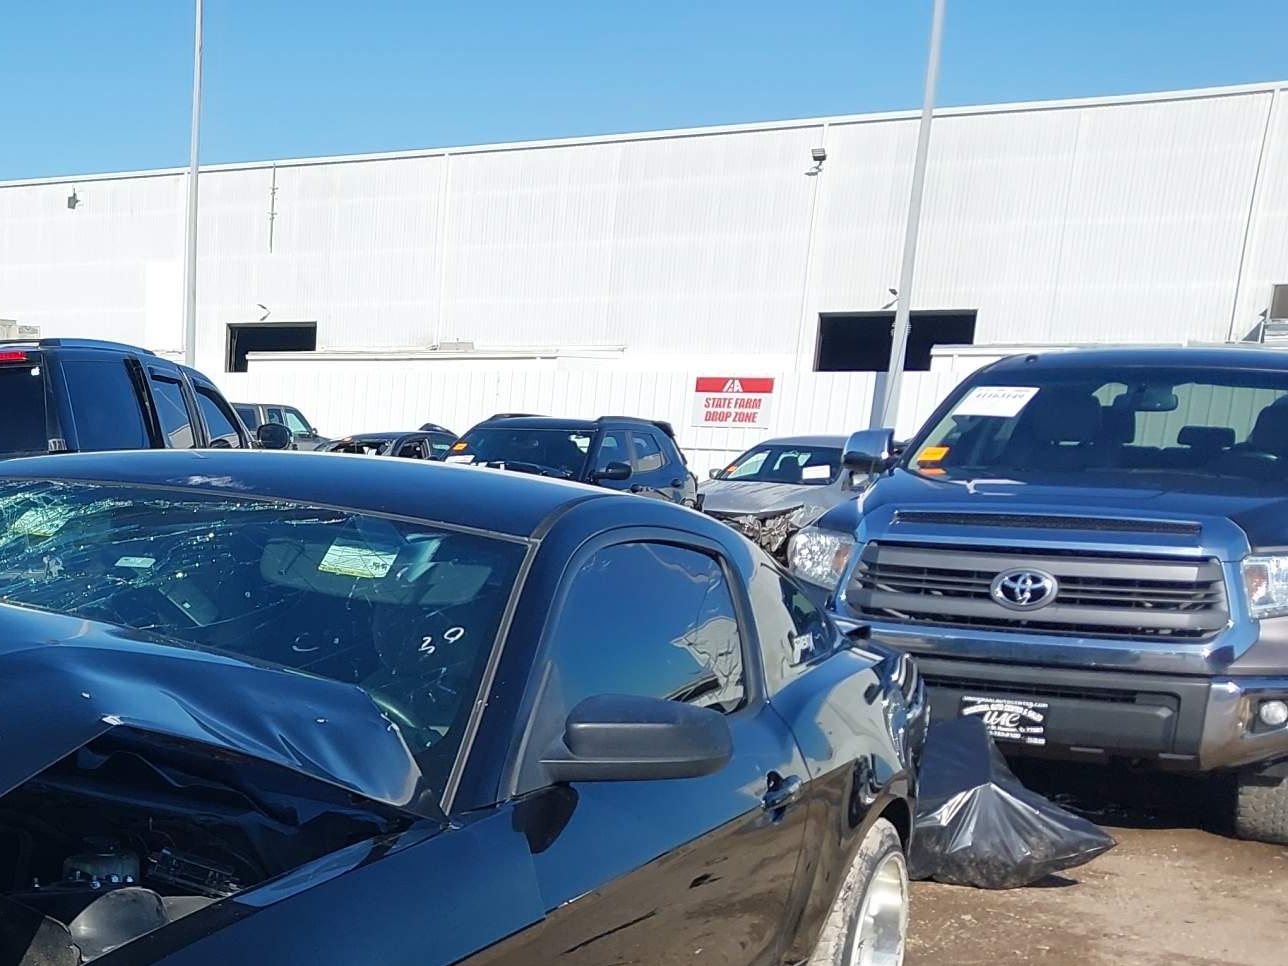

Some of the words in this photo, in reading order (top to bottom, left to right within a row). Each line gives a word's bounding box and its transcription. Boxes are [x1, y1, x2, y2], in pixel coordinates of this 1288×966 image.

[704, 397, 733, 409] STATE
[733, 398, 762, 410] FARM
[704, 411, 732, 423] DROP
[732, 412, 759, 424] ZONE
